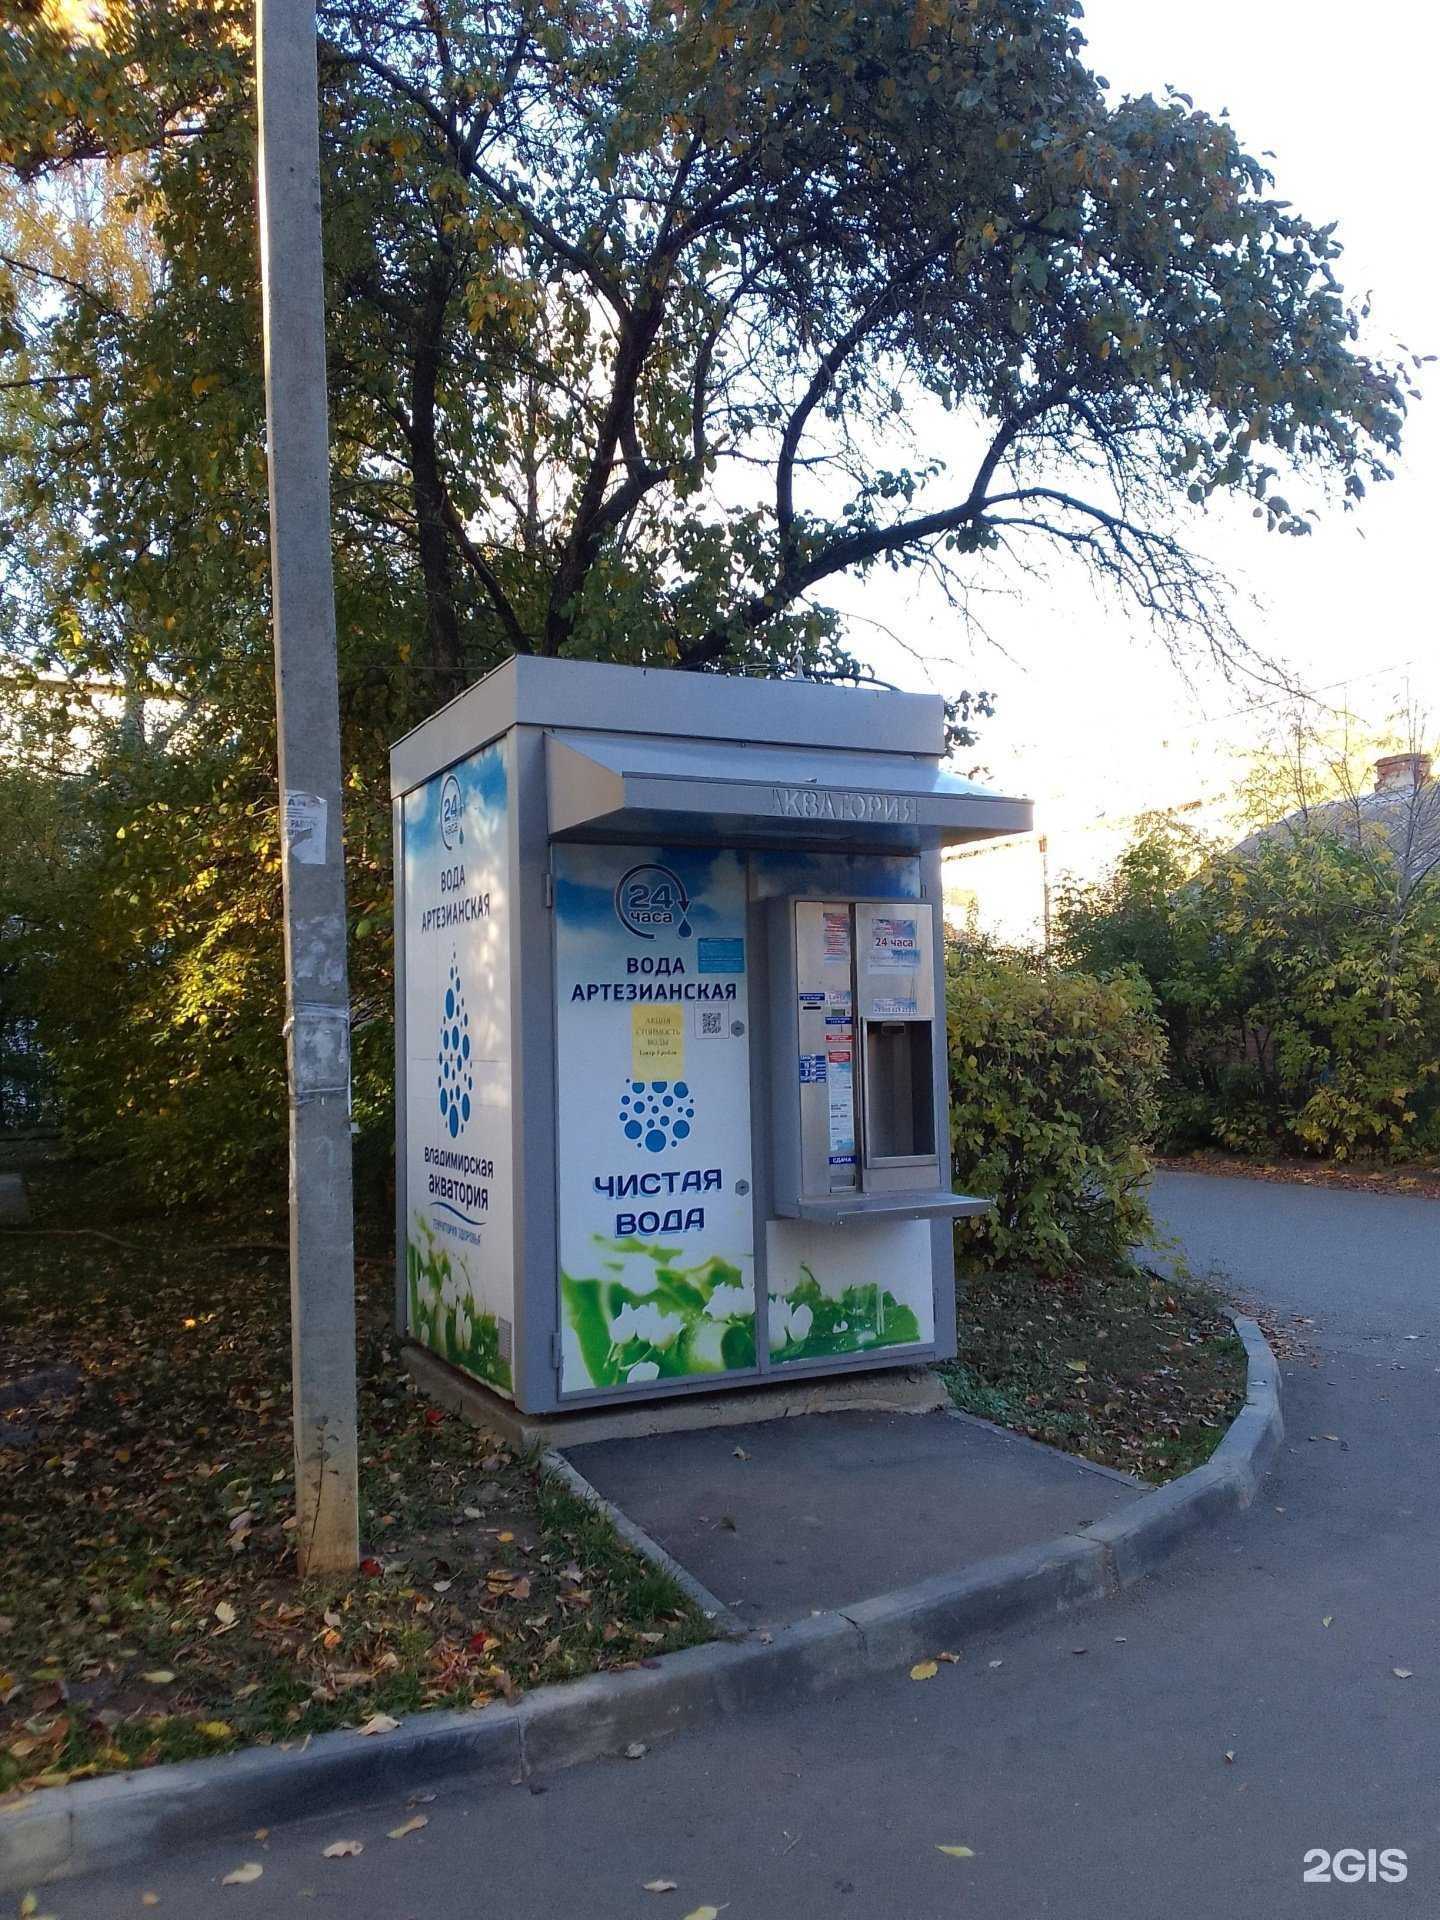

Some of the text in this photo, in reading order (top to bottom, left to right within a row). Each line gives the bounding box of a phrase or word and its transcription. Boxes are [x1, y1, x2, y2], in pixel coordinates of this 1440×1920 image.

[444, 795, 458, 822] 24
[772, 788, 918, 824] АКВАТОРИЯ
[441, 865, 465, 892] ВОДА
[628, 884, 674, 910] 24
[422, 893, 490, 933] АРТЕЗИАНСКАЯ
[630, 911, 673, 924] часа
[875, 937, 913, 947] 24 часа
[626, 957, 685, 976] ВОДА
[571, 983, 737, 1001] АРТЕЗИАНСКАЯ
[429, 1174, 488, 1211] акватория
[593, 1168, 722, 1197] ЧИСТАЯ
[616, 1207, 705, 1236] ВОДА
